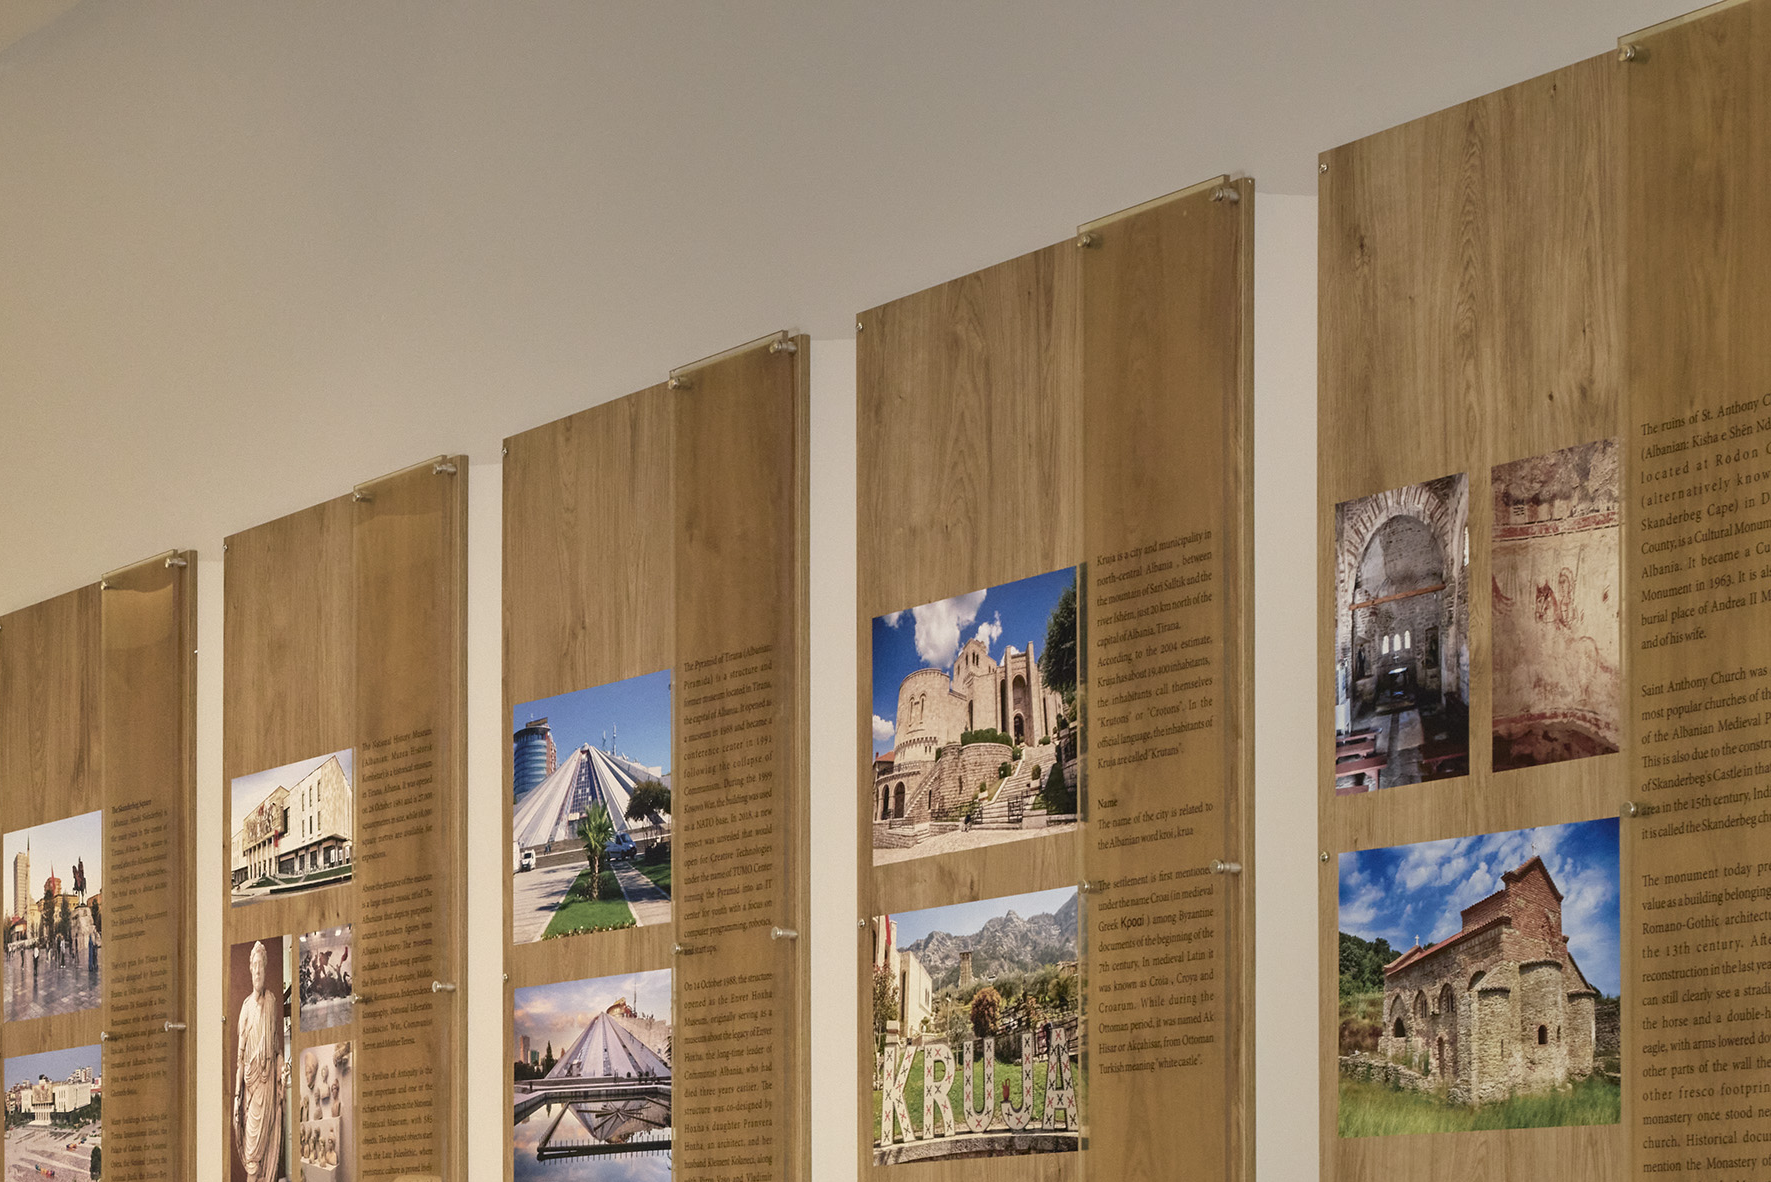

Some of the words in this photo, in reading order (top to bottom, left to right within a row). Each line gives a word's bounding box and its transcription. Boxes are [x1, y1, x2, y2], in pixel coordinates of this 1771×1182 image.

[1641, 421, 1657, 435] The
[1661, 417, 1684, 431] ruins
[1689, 410, 1698, 424] of
[1702, 409, 1712, 421] St.
[1717, 400, 1758, 418] Anthony
[1641, 438, 1688, 462] (Albanian:
[1692, 431, 1718, 448] Kisha
[1721, 433, 1726, 441] e
[1729, 424, 1752, 439] Shën
[1641, 461, 1688, 483] located
[1696, 459, 1707, 471] at
[1715, 449, 1757, 467] Rodon
[1641, 477, 1729, 509] (alternatively
[1641, 509, 1701, 531] Skanderbeg
[1707, 498, 1738, 517] Cape)
[1745, 498, 1754, 509] in
[1097, 554, 1115, 566] Kruja
[1117, 552, 1122, 561] is
[1130, 548, 1141, 558] city
[1144, 541, 1156, 554] and
[1159, 532, 1202, 551] municipality
[1204, 530, 1211, 539] in
[1641, 540, 1676, 555] County,
[1678, 537, 1685, 548] is
[1687, 538, 1692, 546] a
[1694, 524, 1731, 544] Cultural
[1097, 565, 1141, 586] north-central
[1146, 560, 1172, 574] Albania
[1182, 552, 1211, 565] between
[1642, 562, 1682, 578] Albania.
[1688, 557, 1694, 569] It
[1701, 552, 1739, 566] became
[1745, 549, 1749, 558] a
[1641, 582, 1691, 601] Monument
[1696, 580, 1704, 591] in
[1710, 574, 1734, 589] 1963.
[1738, 571, 1745, 583] It
[1749, 569, 1756, 580] is
[1641, 609, 1667, 626] burial
[1671, 607, 1694, 623] place
[1698, 601, 1707, 615] of
[1711, 597, 1745, 613] Andrea
[1750, 593, 1756, 605] II
[1641, 635, 1657, 650] and
[1659, 633, 1668, 646] of
[1670, 631, 1682, 645] his
[1685, 627, 1706, 642] wife.
[1097, 652, 1132, 667] According
[1135, 650, 1142, 659] to
[1146, 645, 1156, 656] the
[1161, 642, 1177, 653] 2004
[1097, 696, 1108, 708] the
[1112, 689, 1151, 705] inhabitants
[1155, 683, 1168, 695] call
[1172, 676, 1212, 692] themselves
[1642, 683, 1663, 697] Saint
[1667, 676, 1707, 692] Anthony
[1710, 666, 1745, 685] Church
[1749, 668, 1766, 678] was
[1189, 699, 1196, 709] In
[1200, 695, 1212, 707] the
[1642, 707, 1663, 720] most
[1667, 700, 1701, 719] popular
[1704, 692, 1746, 710] churches
[1749, 689, 1758, 702] of
[1097, 734, 1119, 749] official
[1153, 726, 1164, 737] the
[1166, 720, 1203, 735] inhabitants
[1205, 716, 1212, 727] of
[1641, 731, 1650, 744] of
[1654, 729, 1668, 742] the
[1672, 724, 1713, 739] Albanian
[1718, 713, 1760, 732] Medieval
[1098, 758, 1115, 769] Kruja
[1128, 749, 1147, 763] called
[1642, 755, 1660, 768] This
[1663, 754, 1669, 765] is
[1672, 750, 1689, 764] also
[1691, 748, 1708, 761] due
[1711, 747, 1719, 758] to
[1722, 742, 1736, 756] the
[1642, 779, 1650, 792] of
[1713, 766, 1741, 781] Castle
[1743, 766, 1752, 777] in
[1098, 798, 1117, 808] Name
[1098, 818, 1110, 830] The
[1112, 818, 1130, 827] name
[1133, 812, 1140, 823] of
[1143, 810, 1153, 822] the
[1156, 809, 1168, 820] city
[1171, 807, 1176, 816] is
[1179, 801, 1202, 815] related
[1205, 802, 1212, 810] to
[1641, 806, 1659, 816] area
[1663, 802, 1670, 813] in
[1674, 798, 1687, 811] the
[1691, 793, 1710, 810] 15th
[1713, 792, 1750, 805] century,
[1642, 829, 1647, 840] it
[1650, 828, 1656, 839] is
[1658, 822, 1684, 838] called
[1686, 820, 1700, 834] the
[1702, 813, 1756, 831] Skanderbeg
[1141, 996, 1164, 1008] While
[1169, 993, 1196, 1004] during
[1201, 989, 1213, 1000] the
[880, 1027, 1078, 1147] KRUJA
